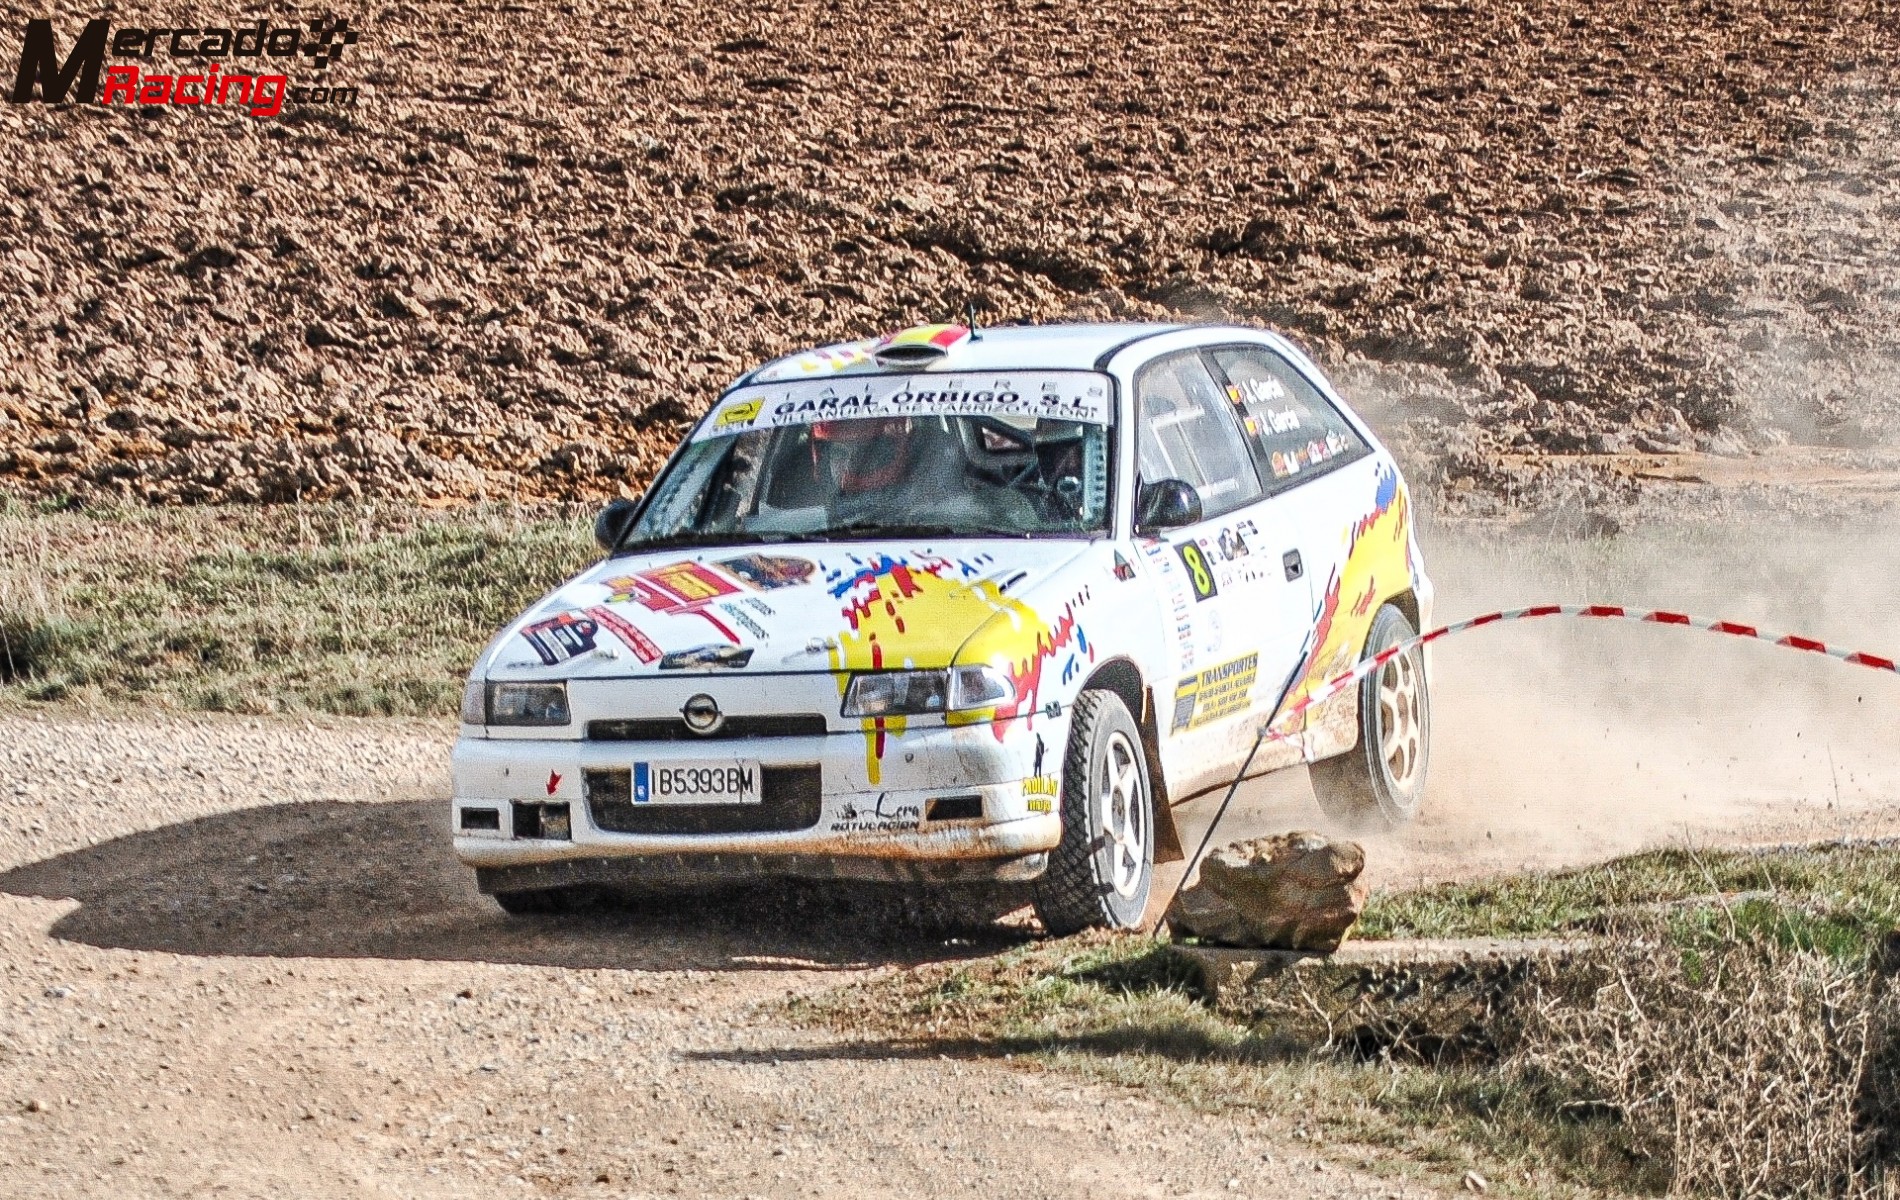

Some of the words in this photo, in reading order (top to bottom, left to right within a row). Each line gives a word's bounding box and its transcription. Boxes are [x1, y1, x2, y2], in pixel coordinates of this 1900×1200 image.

[774, 394, 879, 415] GARAL
[1183, 544, 1212, 597] 8
[651, 767, 754, 795] IB5393BM
